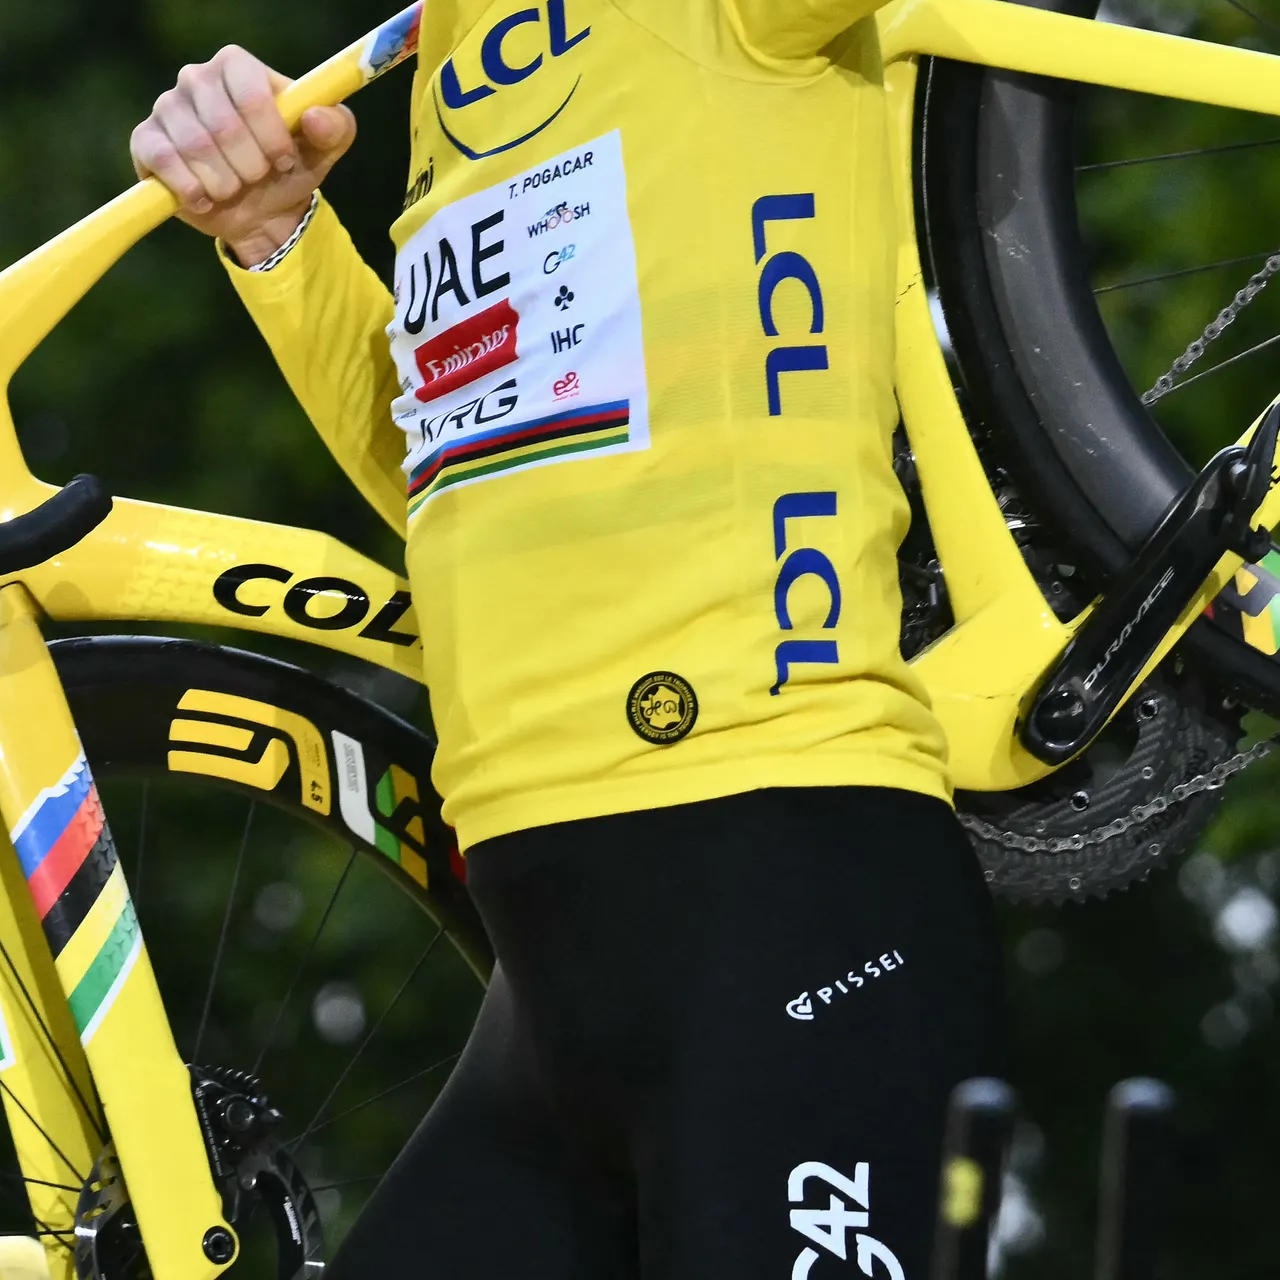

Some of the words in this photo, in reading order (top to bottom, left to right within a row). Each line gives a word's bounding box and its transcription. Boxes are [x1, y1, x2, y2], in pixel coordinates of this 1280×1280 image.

[508, 183, 519, 200] T.
[522, 151, 594, 194] POGACAR
[403, 209, 511, 335] UAE
[543, 243, 576, 275] G42
[751, 192, 829, 416] LCL
[424, 322, 511, 384] Emirates
[550, 323, 585, 354] IHC
[213, 563, 422, 647] COL
[770, 491, 842, 696] LCL
[309, 779, 323, 804] 4.5
[816, 949, 904, 1004] PISSEI
